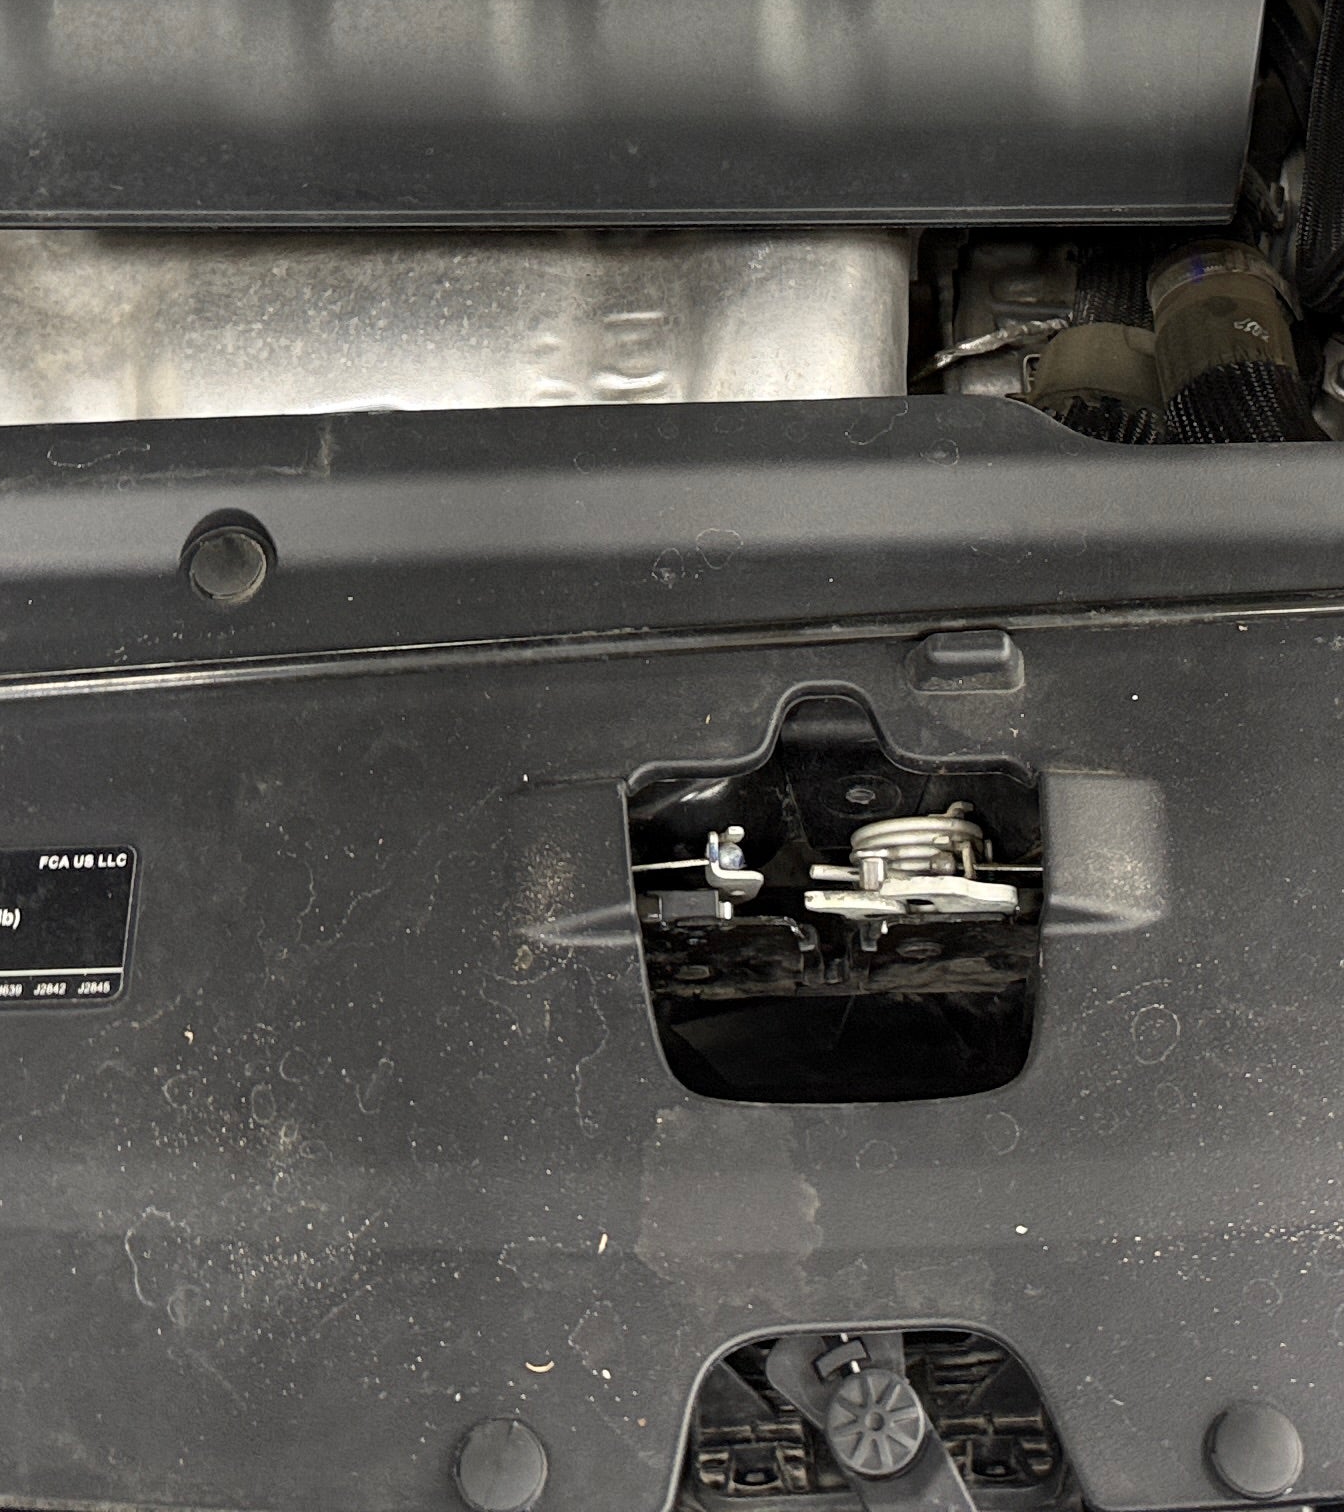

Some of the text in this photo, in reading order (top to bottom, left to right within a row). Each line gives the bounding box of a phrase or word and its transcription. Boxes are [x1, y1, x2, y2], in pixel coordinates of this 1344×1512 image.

[39, 853, 128, 870] FCA US LLC
